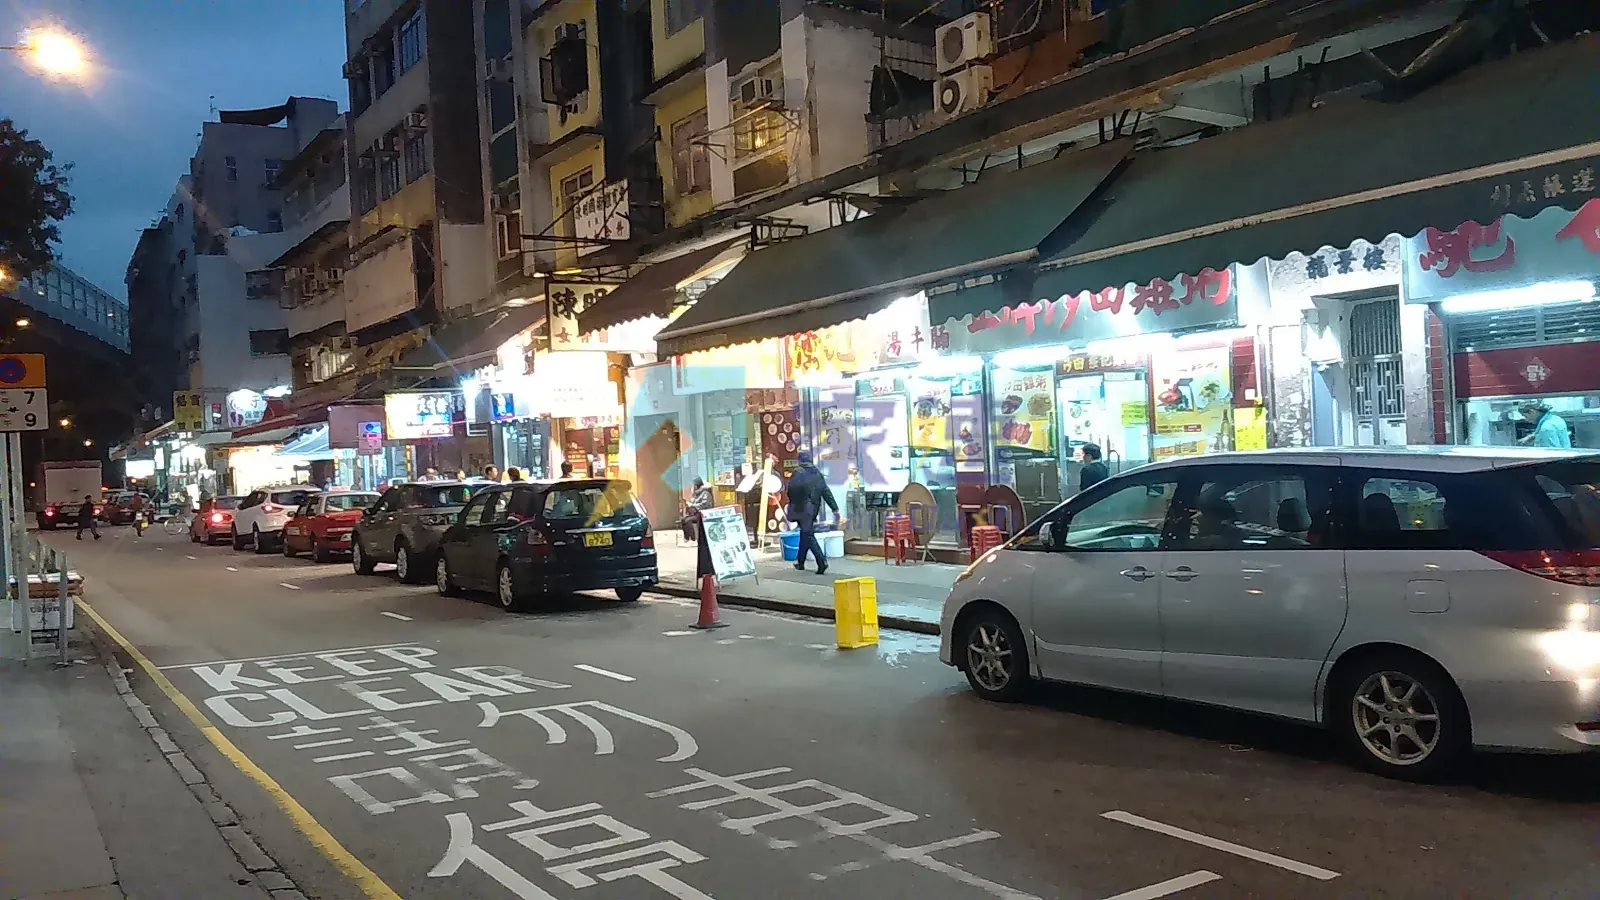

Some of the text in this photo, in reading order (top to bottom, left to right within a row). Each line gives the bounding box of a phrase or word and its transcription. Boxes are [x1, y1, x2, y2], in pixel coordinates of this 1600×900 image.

[24, 391, 35, 405] 7
[24, 412, 37, 427] 9
[190, 645, 438, 692] KEEP
[203, 665, 573, 728] CLEAR
